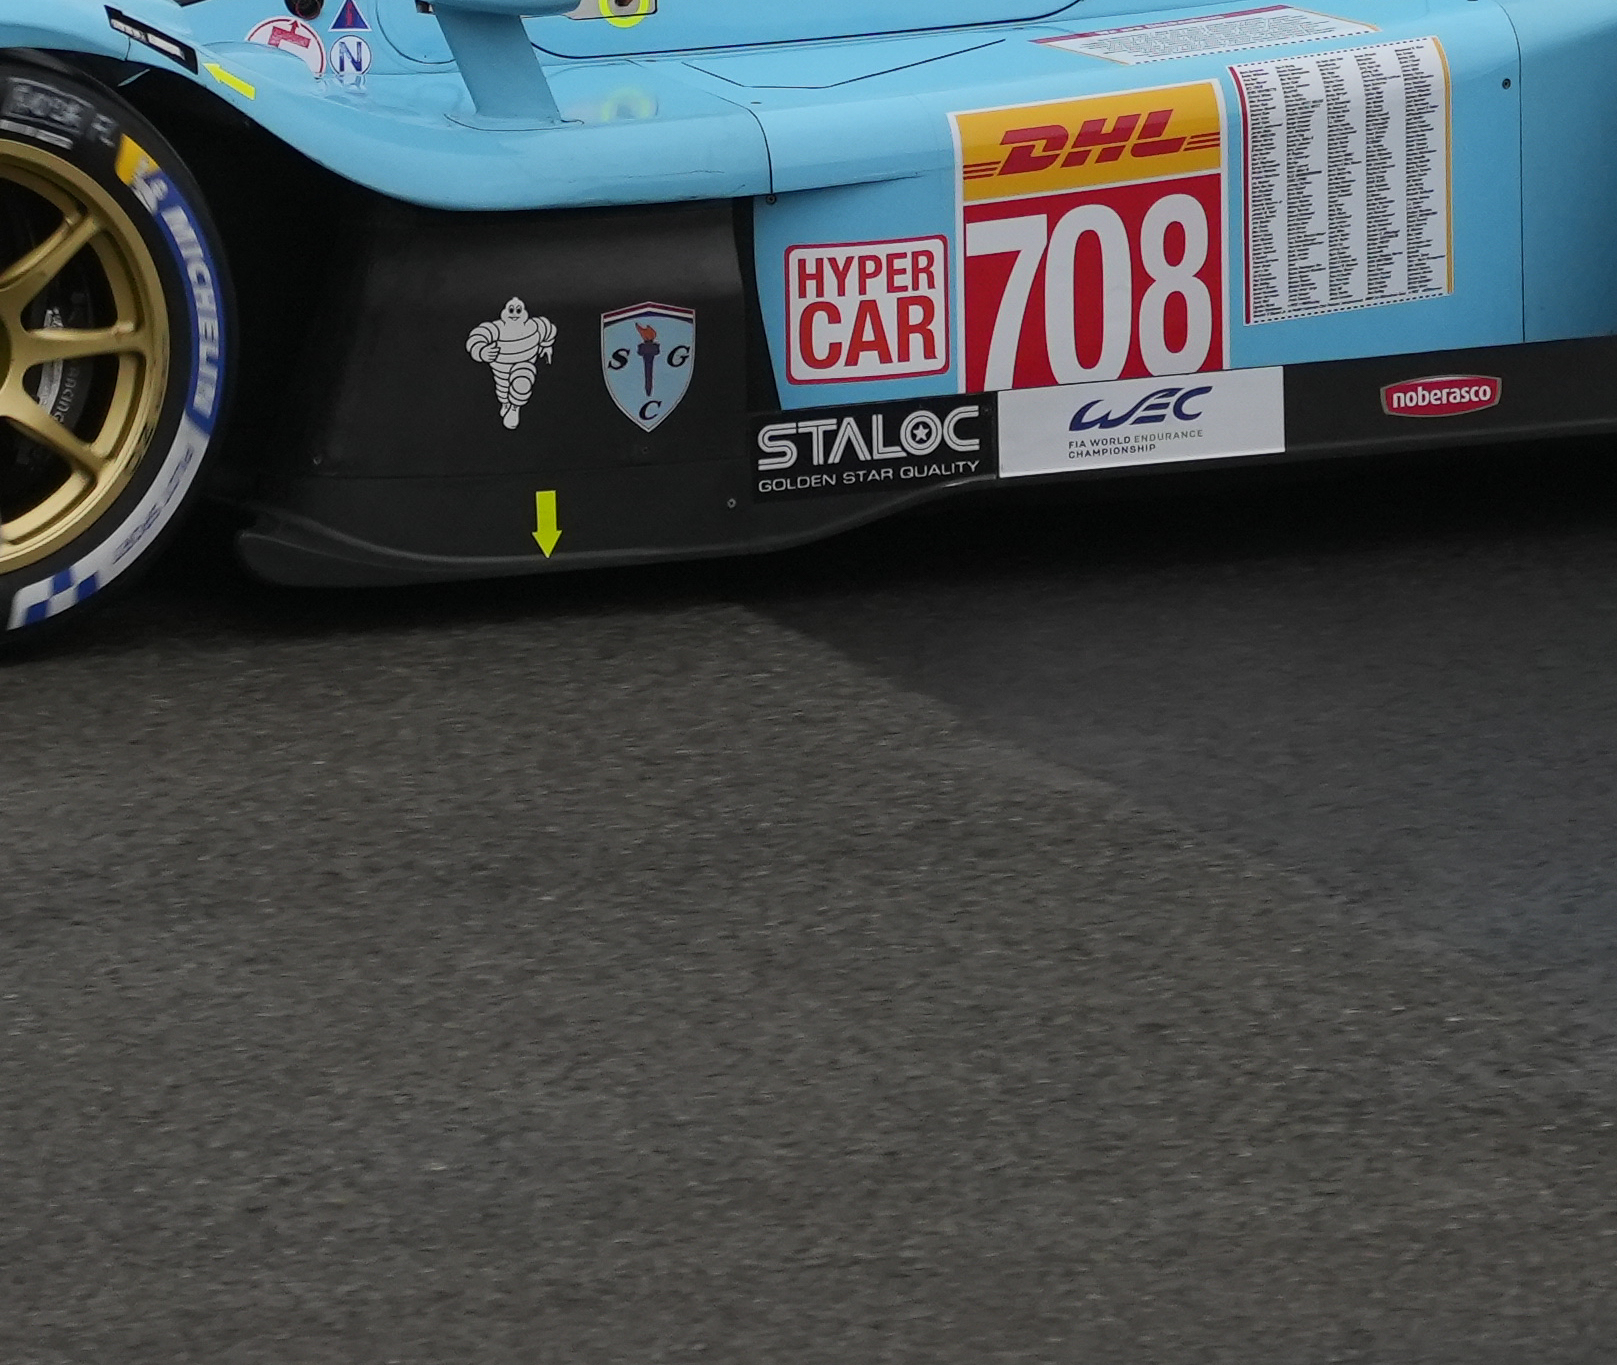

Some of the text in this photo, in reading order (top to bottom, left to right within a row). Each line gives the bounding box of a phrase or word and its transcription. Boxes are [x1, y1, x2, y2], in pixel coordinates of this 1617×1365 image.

[996, 109, 1186, 176] DHL
[798, 250, 936, 299] HYPER
[965, 193, 1213, 392] 708
[163, 205, 221, 418] MICHELIN
[798, 295, 936, 369] CAR
[607, 347, 630, 369] S
[666, 344, 691, 367] G
[638, 399, 662, 421] C
[1069, 386, 1213, 432] WEC
[1391, 383, 1492, 408] noberasco
[758, 405, 980, 472] STALOC
[1068, 429, 1204, 450] FIA WORLD ENDURANCE
[1068, 443, 1156, 459] CHAMPIONSHIP
[758, 460, 980, 494] GOLDEN STAR QUALITY
